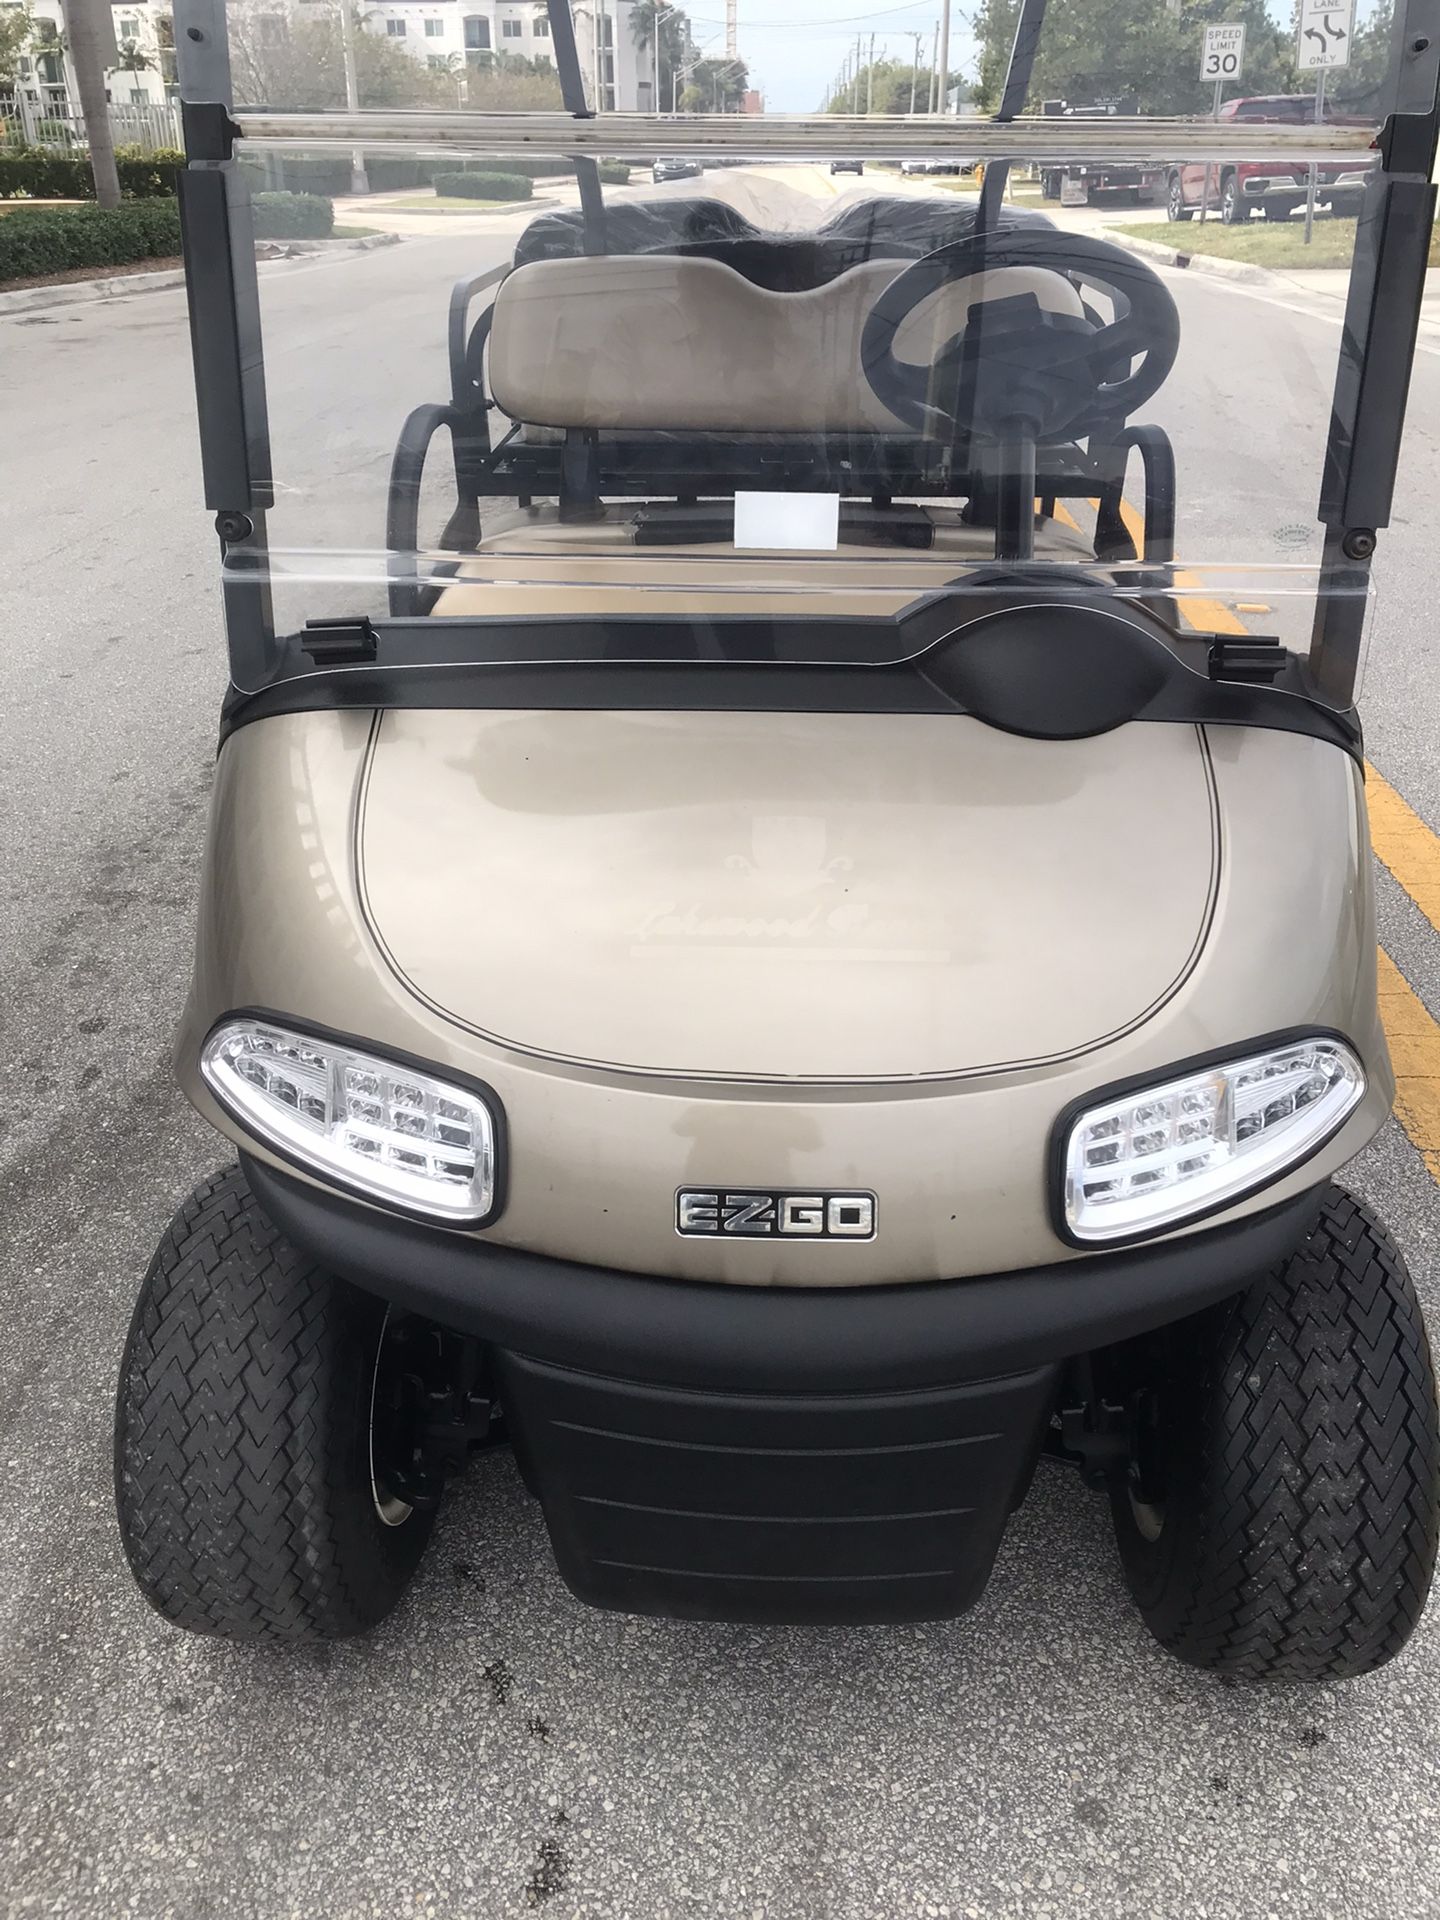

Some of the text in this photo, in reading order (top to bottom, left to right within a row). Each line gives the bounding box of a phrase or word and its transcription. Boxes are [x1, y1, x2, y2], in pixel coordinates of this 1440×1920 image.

[1313, 0, 1341, 8] LANE
[1208, 29, 1242, 40] SPEED
[1210, 40, 1237, 51] LIMIT
[1206, 53, 1238, 74] 30
[1309, 54, 1337, 65] ONLY
